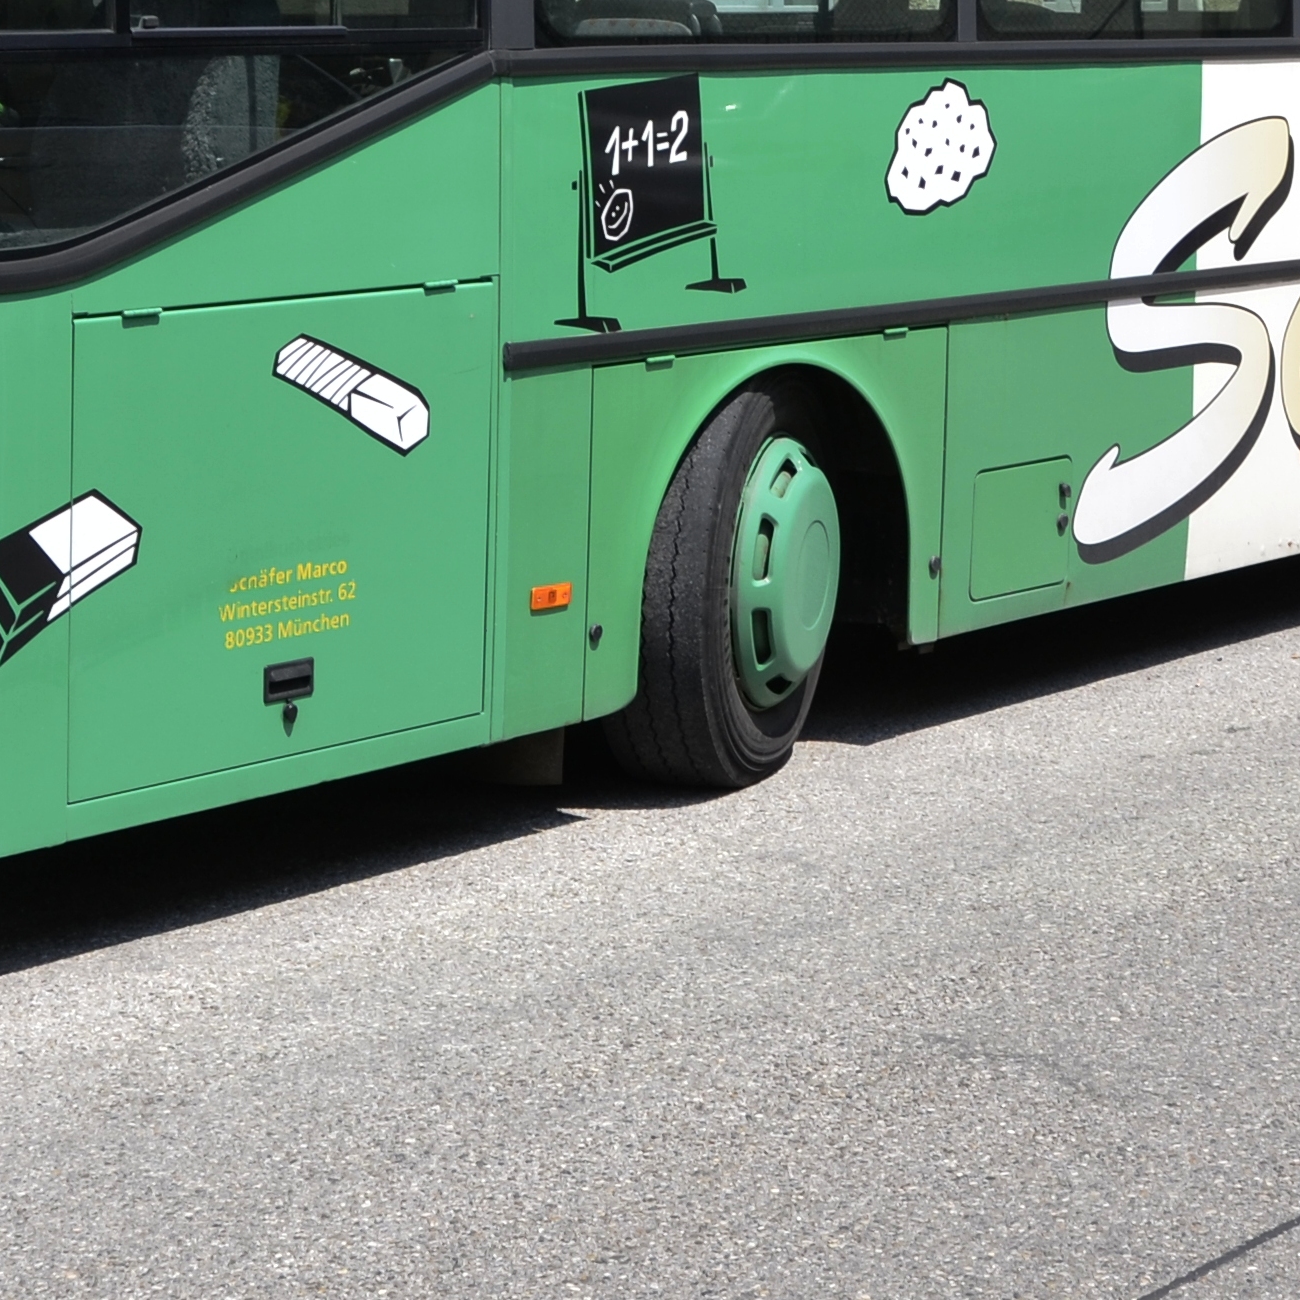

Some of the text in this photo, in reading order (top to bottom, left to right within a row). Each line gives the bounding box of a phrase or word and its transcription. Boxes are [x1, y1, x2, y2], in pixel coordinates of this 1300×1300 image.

[604, 110, 689, 175] 1+1=2
[296, 560, 348, 582] Marco
[218, 580, 357, 622] Wintersteinstr. 62
[224, 612, 350, 649] 80933 München
